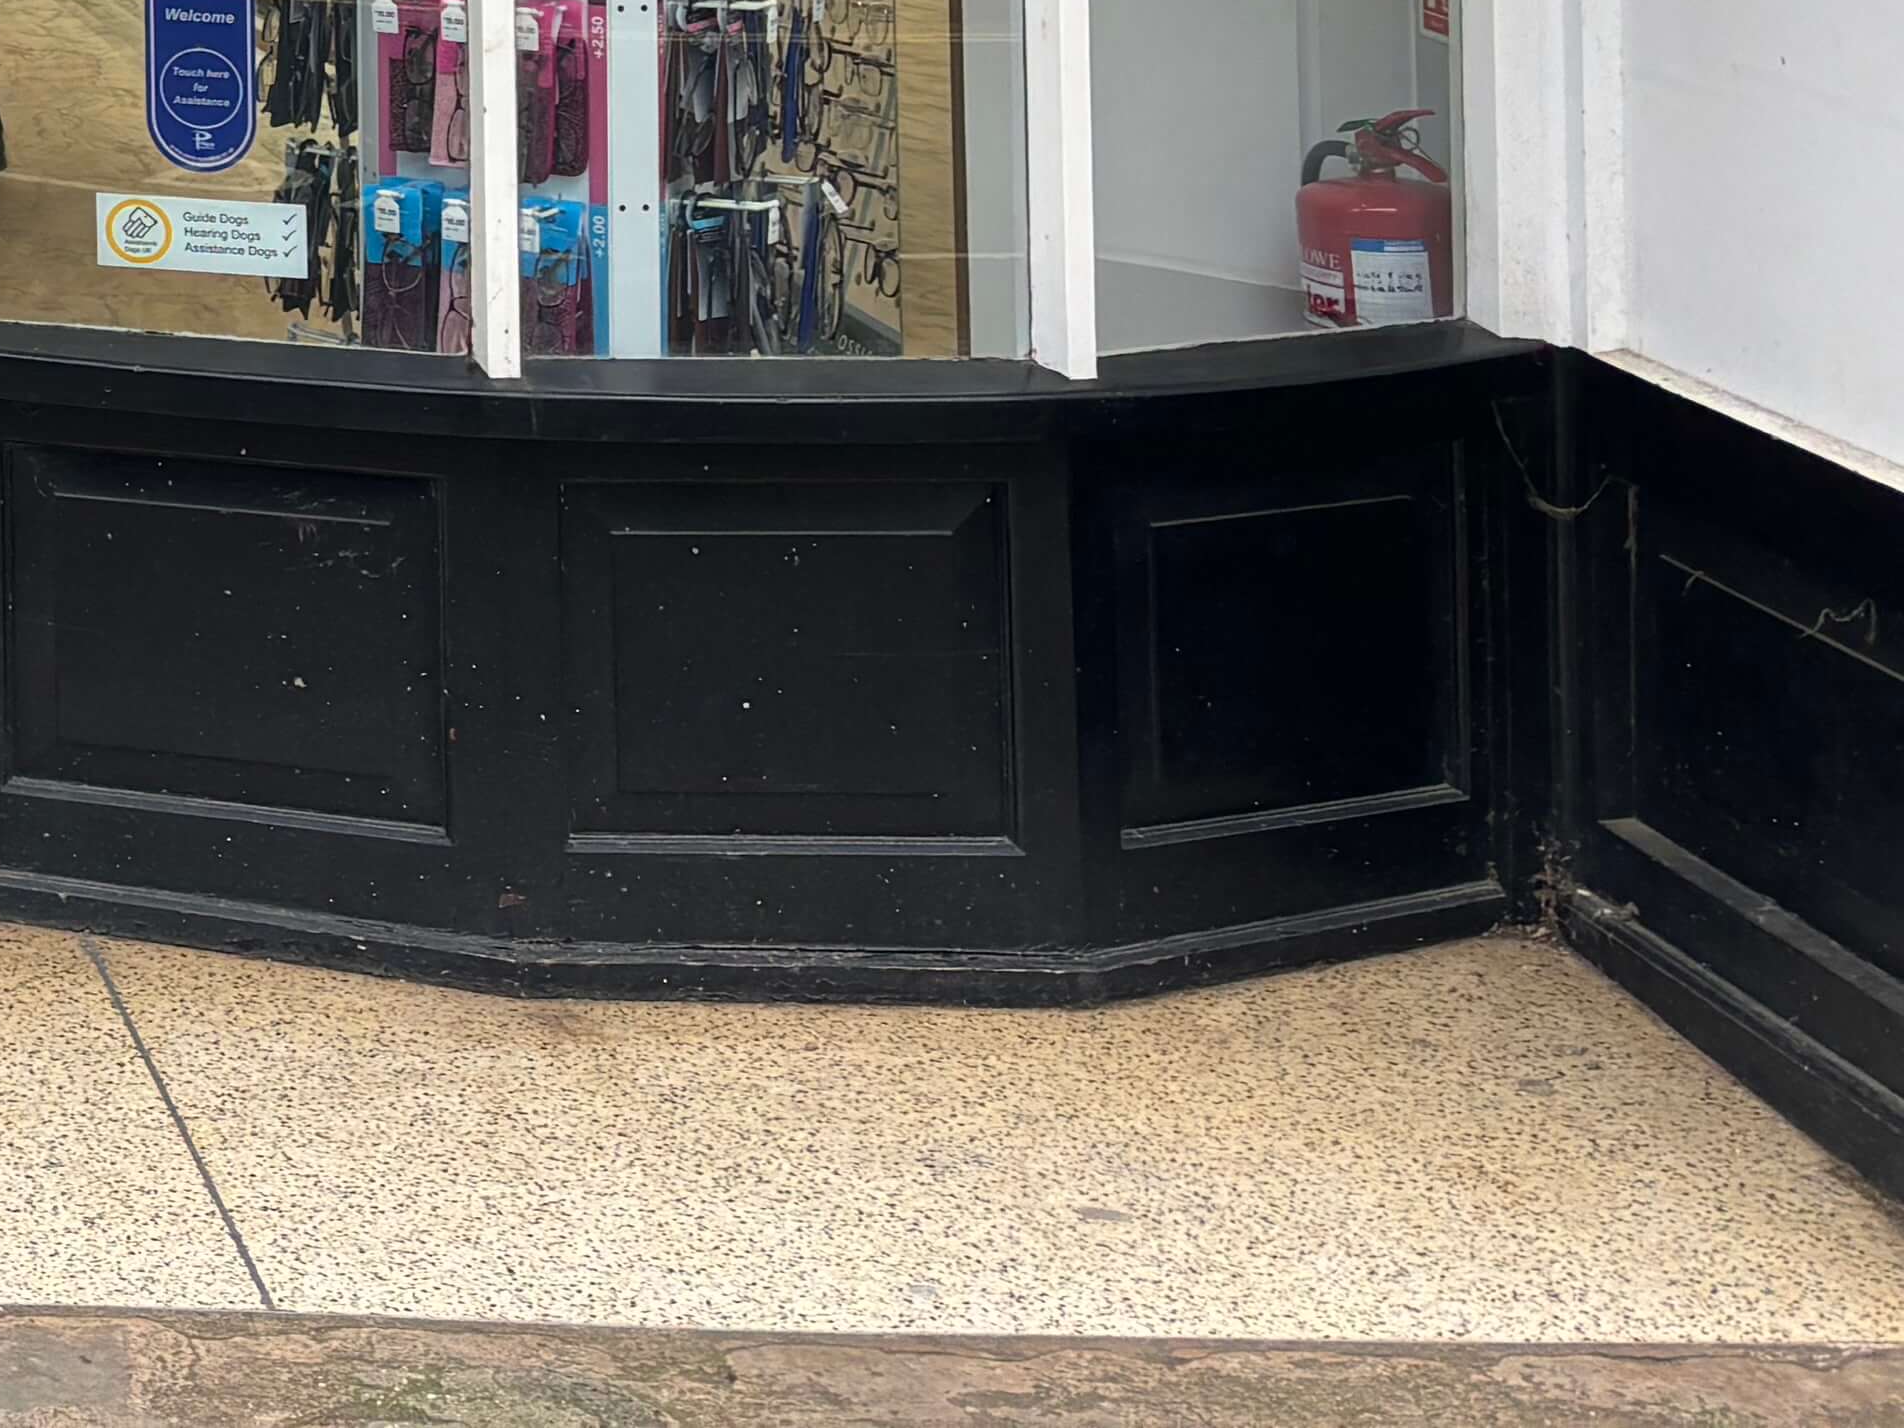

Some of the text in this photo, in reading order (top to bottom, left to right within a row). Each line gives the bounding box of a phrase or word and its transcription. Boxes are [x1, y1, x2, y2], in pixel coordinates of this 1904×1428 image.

[164, 7, 236, 26] Welcome
[591, 16, 605, 59] +2.50
[172, 65, 231, 79] Touch here
[193, 81, 209, 93] for
[172, 95, 231, 108] Assistance
[182, 211, 249, 227] Guide Dogs
[184, 227, 261, 243] Hearing Dogs
[592, 214, 606, 258] +2.00
[184, 242, 278, 259] Assistance Dogs
